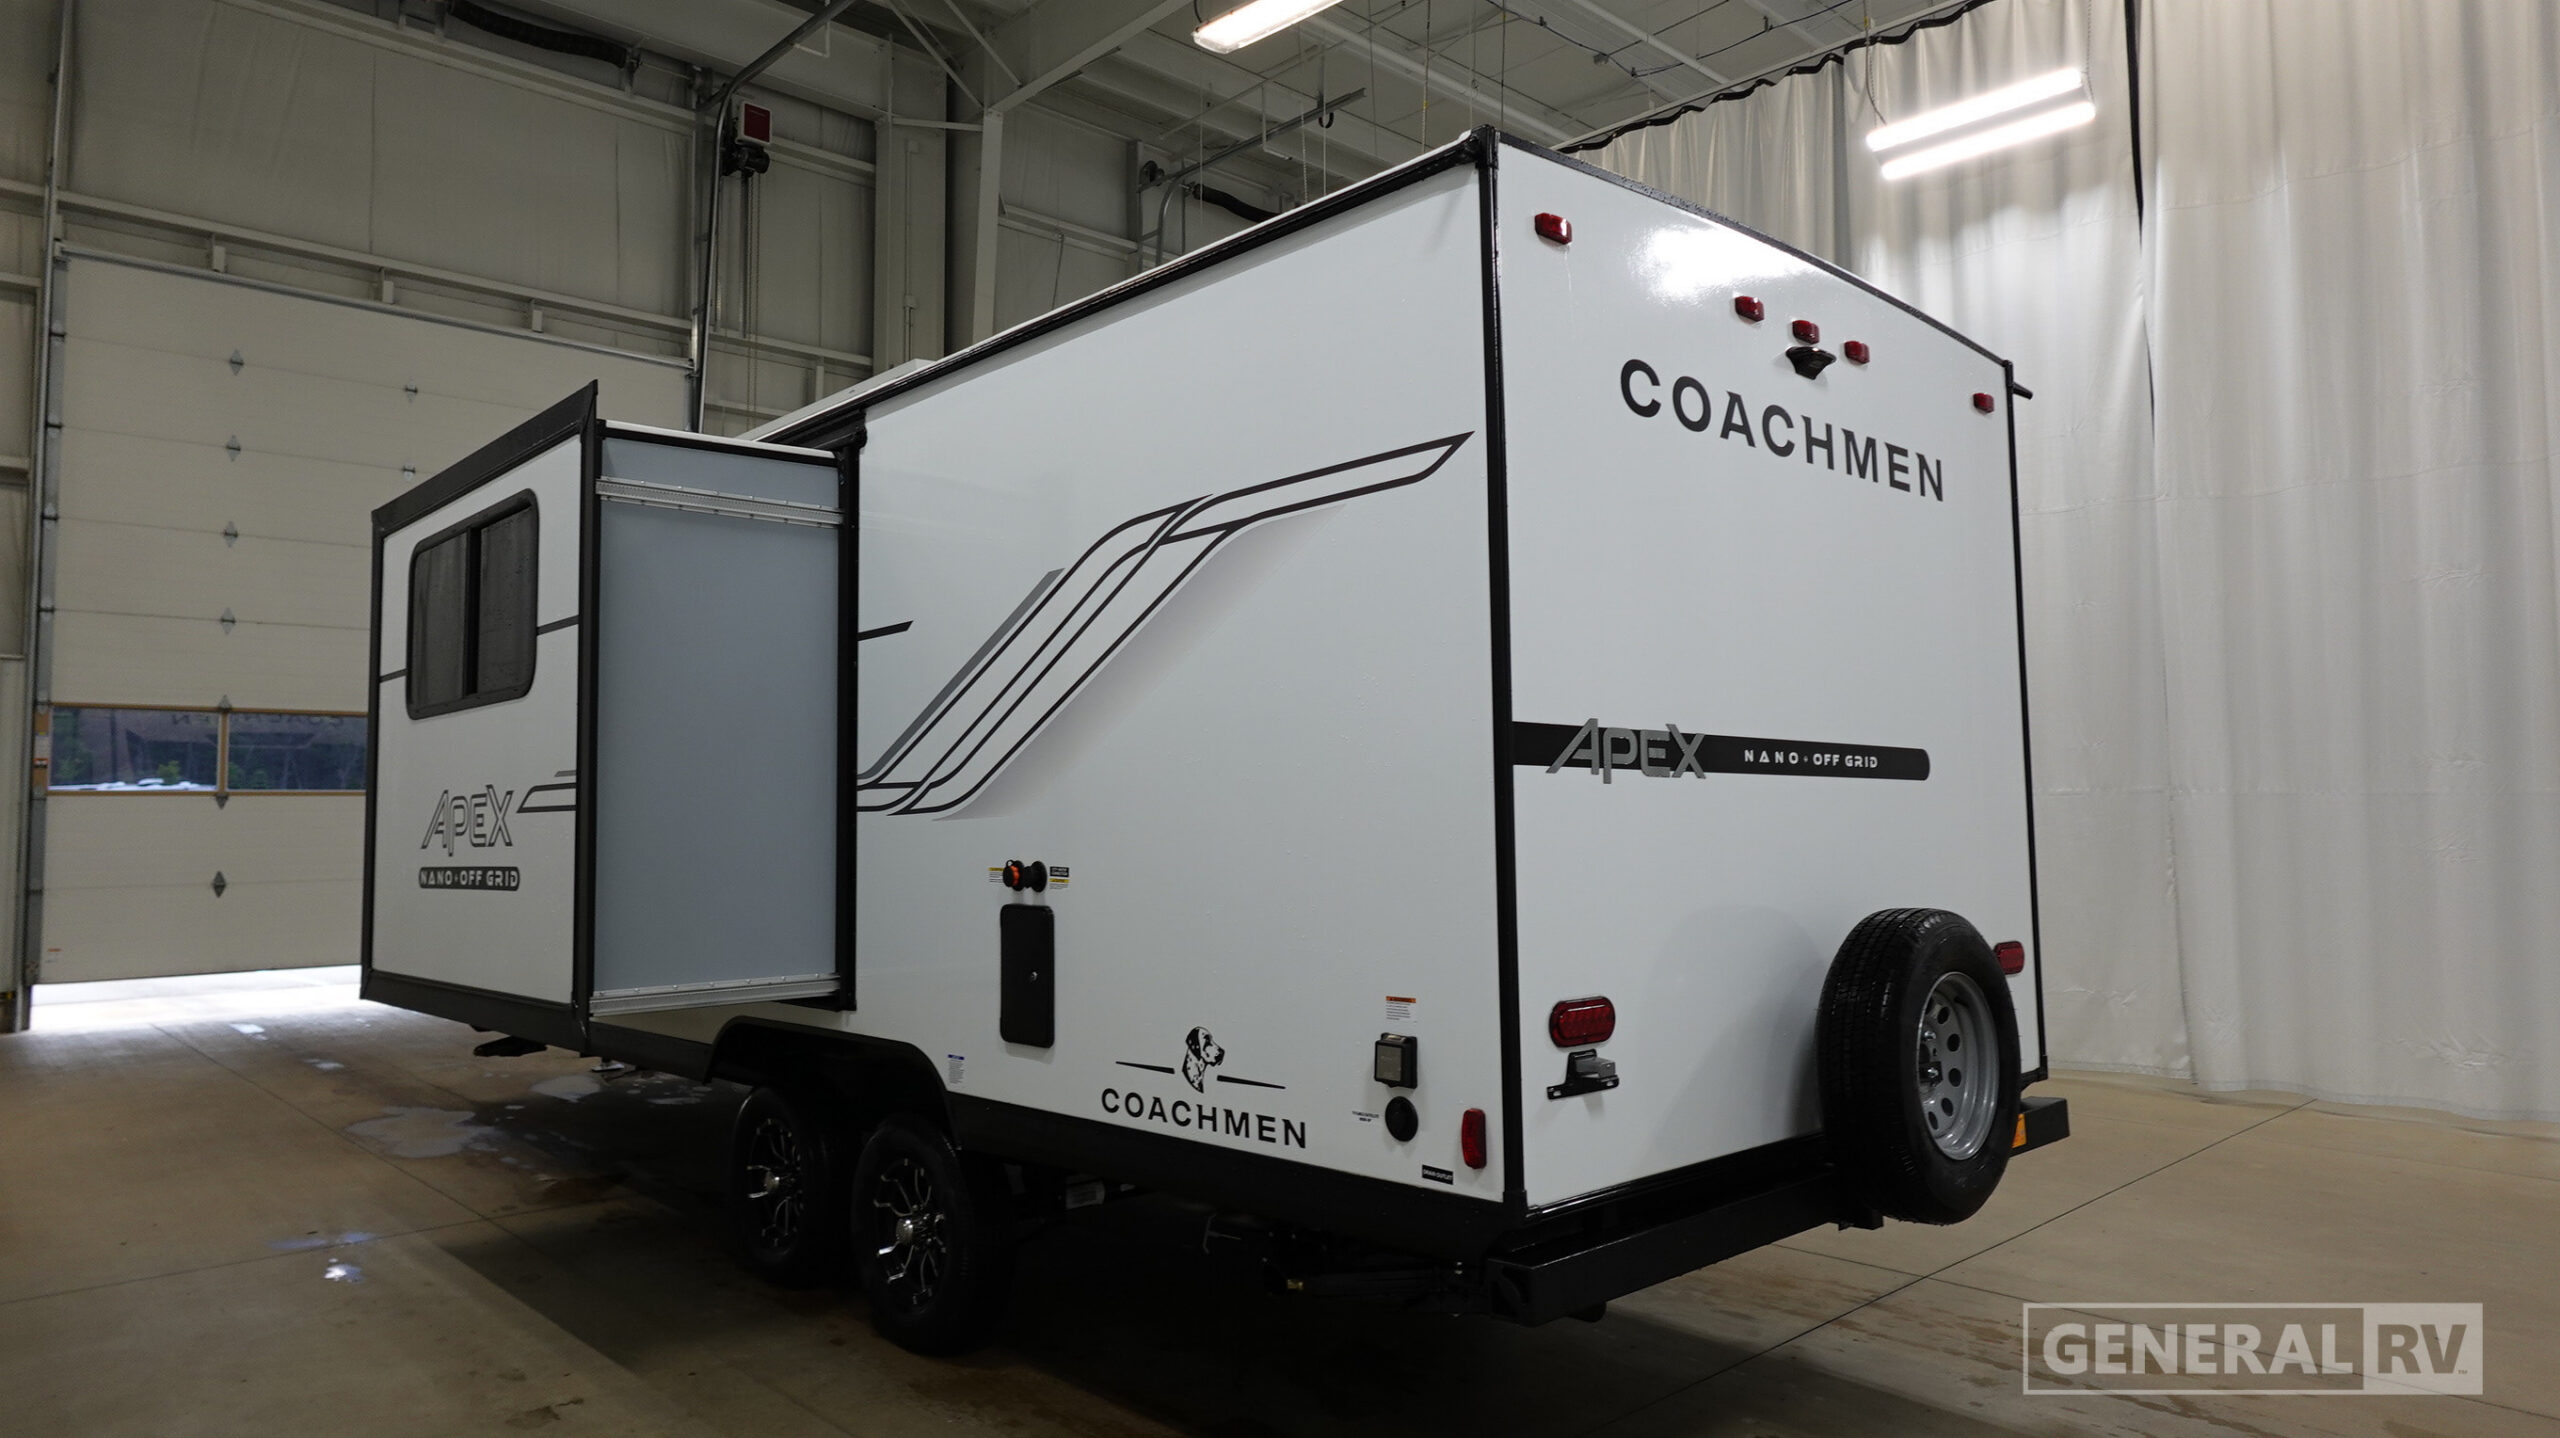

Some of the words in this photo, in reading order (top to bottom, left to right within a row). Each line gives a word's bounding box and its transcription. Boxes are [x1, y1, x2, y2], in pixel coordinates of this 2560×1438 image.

[1620, 358, 1944, 502] COACHMEN
[1545, 718, 1706, 784] APEX
[1744, 750, 1799, 764] NANO
[1812, 753, 1840, 766] OFF
[1844, 755, 1878, 768] GRID
[421, 784, 514, 857] APEX
[420, 870, 453, 885] NANO
[460, 870, 483, 886] OFF
[486, 870, 518, 887] GRID
[1101, 1088, 1306, 1149] COACHMEN
